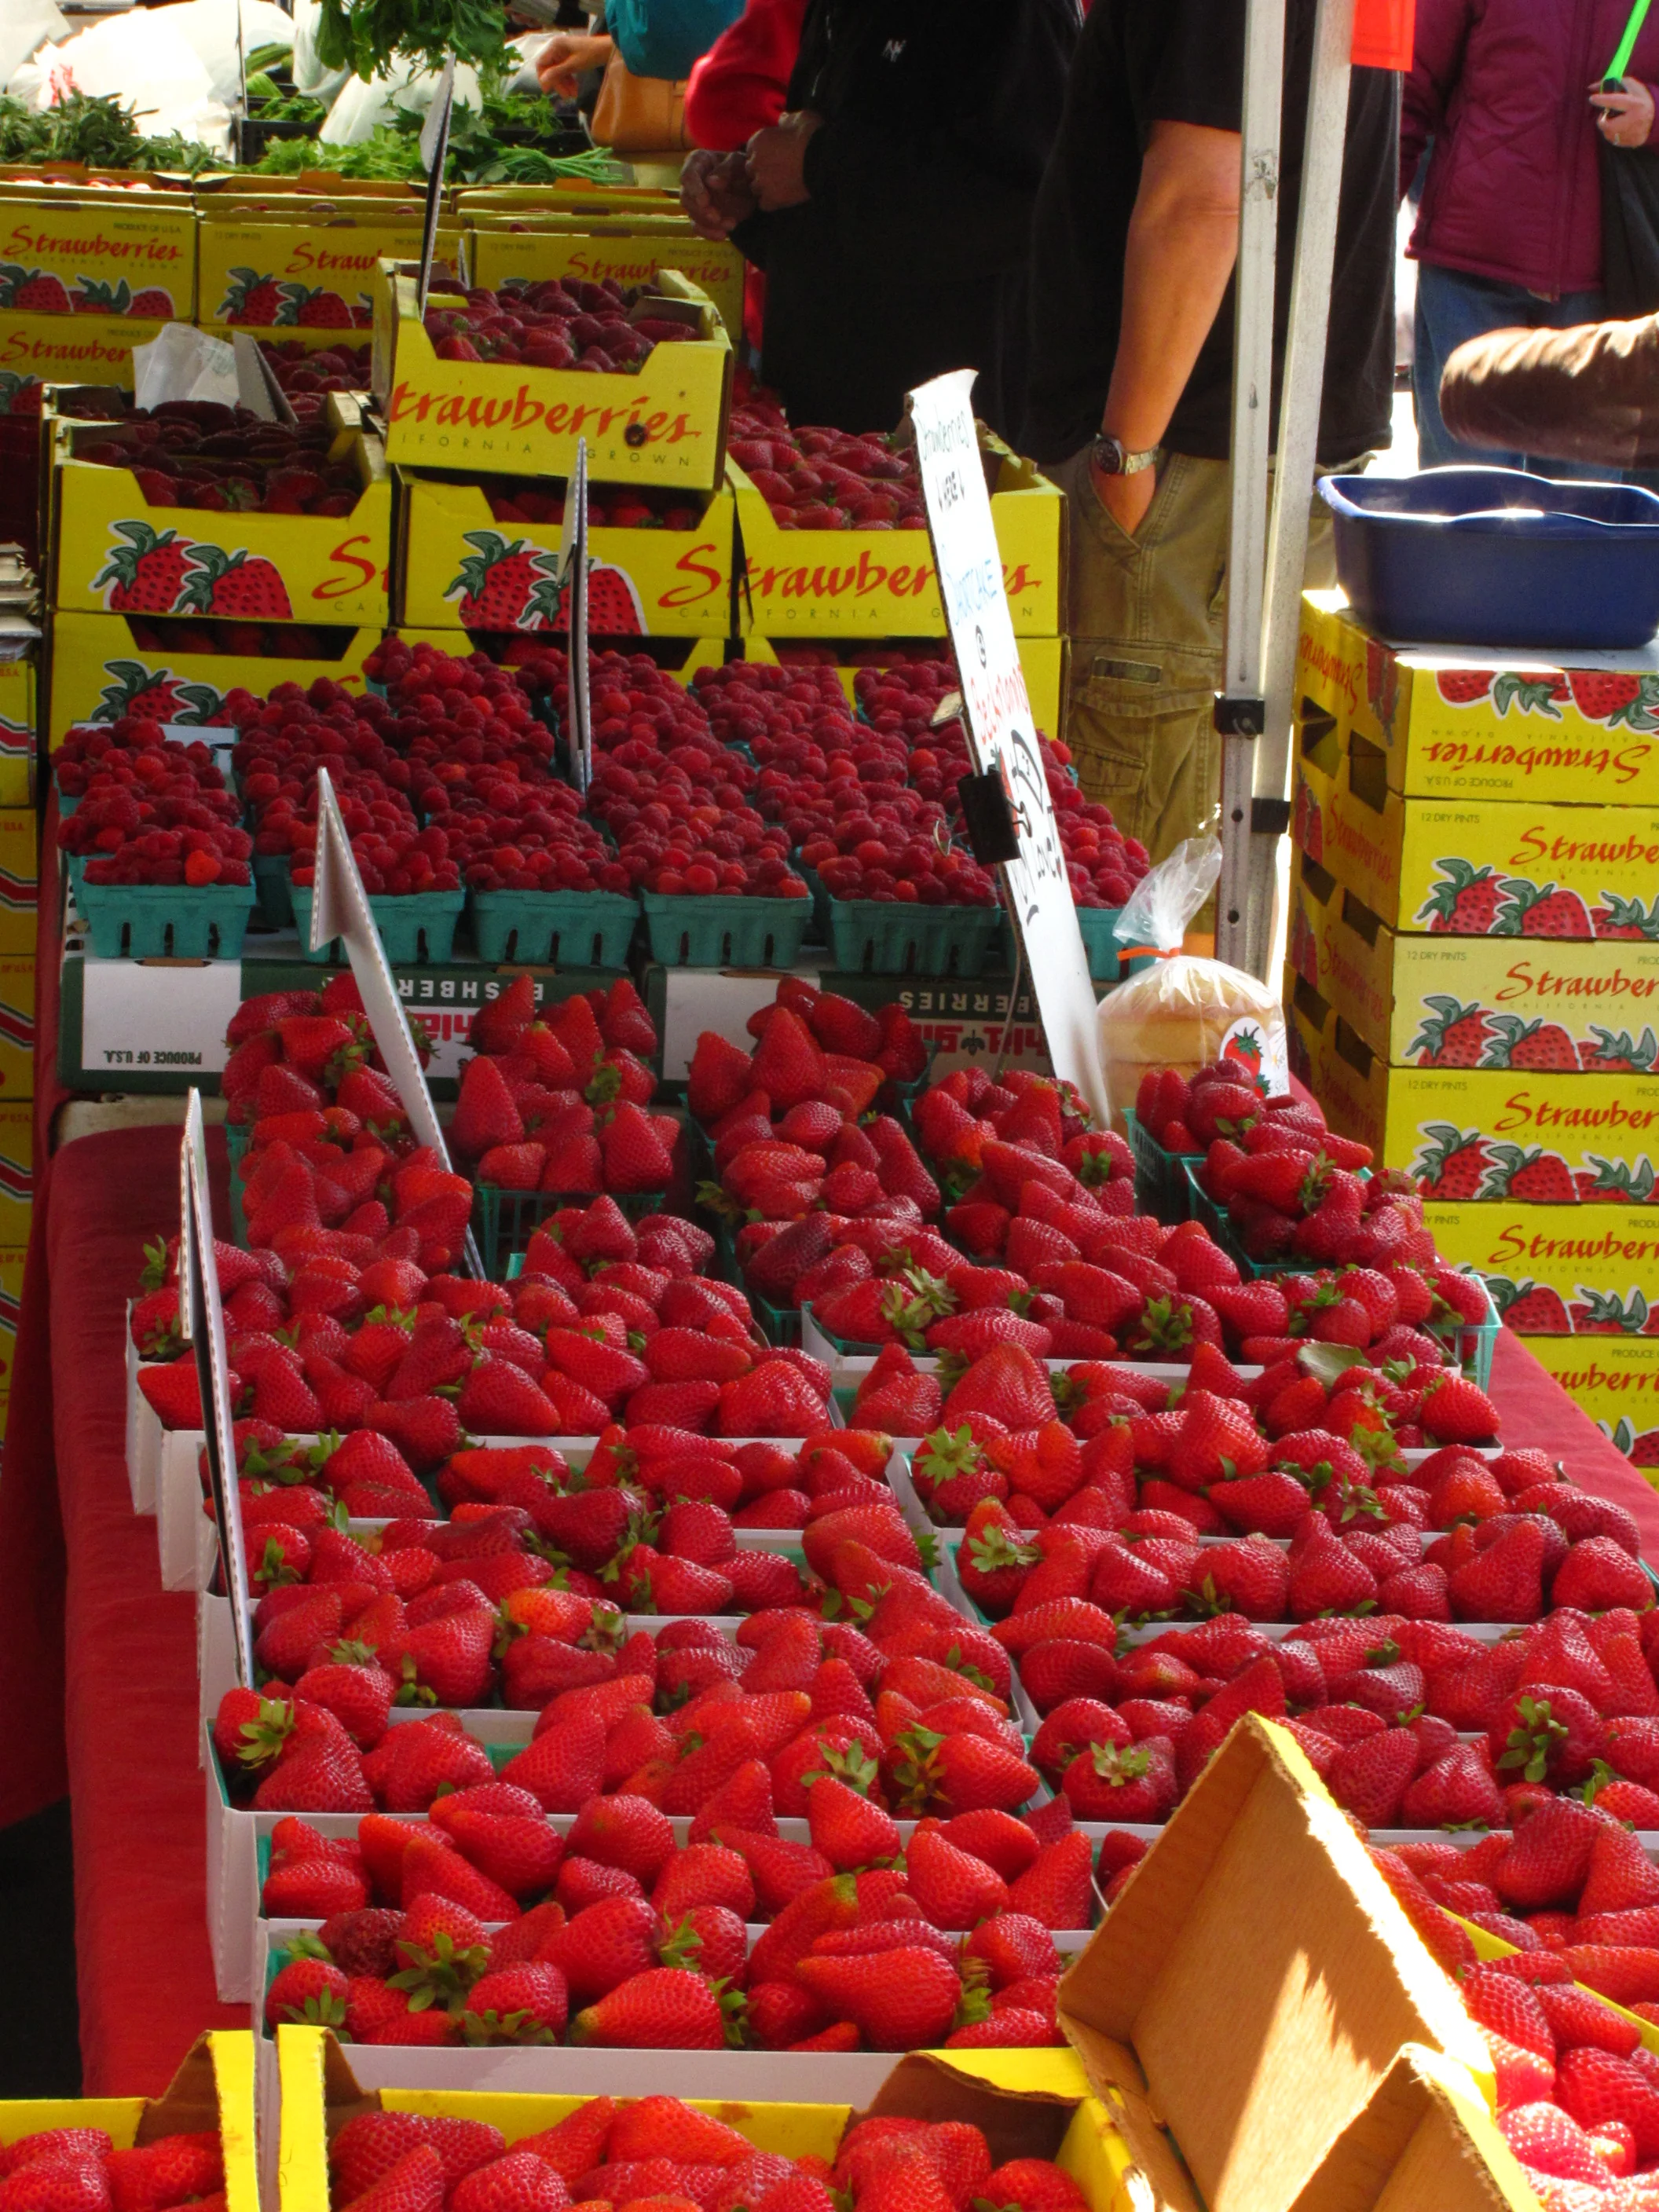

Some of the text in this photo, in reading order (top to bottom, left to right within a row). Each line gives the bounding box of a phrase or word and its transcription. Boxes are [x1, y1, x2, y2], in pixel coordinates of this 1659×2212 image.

[3, 225, 184, 261] Strawberries
[587, 448, 690, 467] GROWN
[1421, 742, 1652, 785] Strawberries
[1421, 812, 1481, 824] 12 DRY PINTS
[1407, 950, 1467, 961] 12 DRY PINTS
[136, 1051, 151, 1064] OF
[153, 1051, 203, 1065] PRODUCE
[1420, 1080, 1440, 1090] DRY
[1441, 1081, 1468, 1091] PINTS
[1434, 1215, 1460, 1225] PINTS
